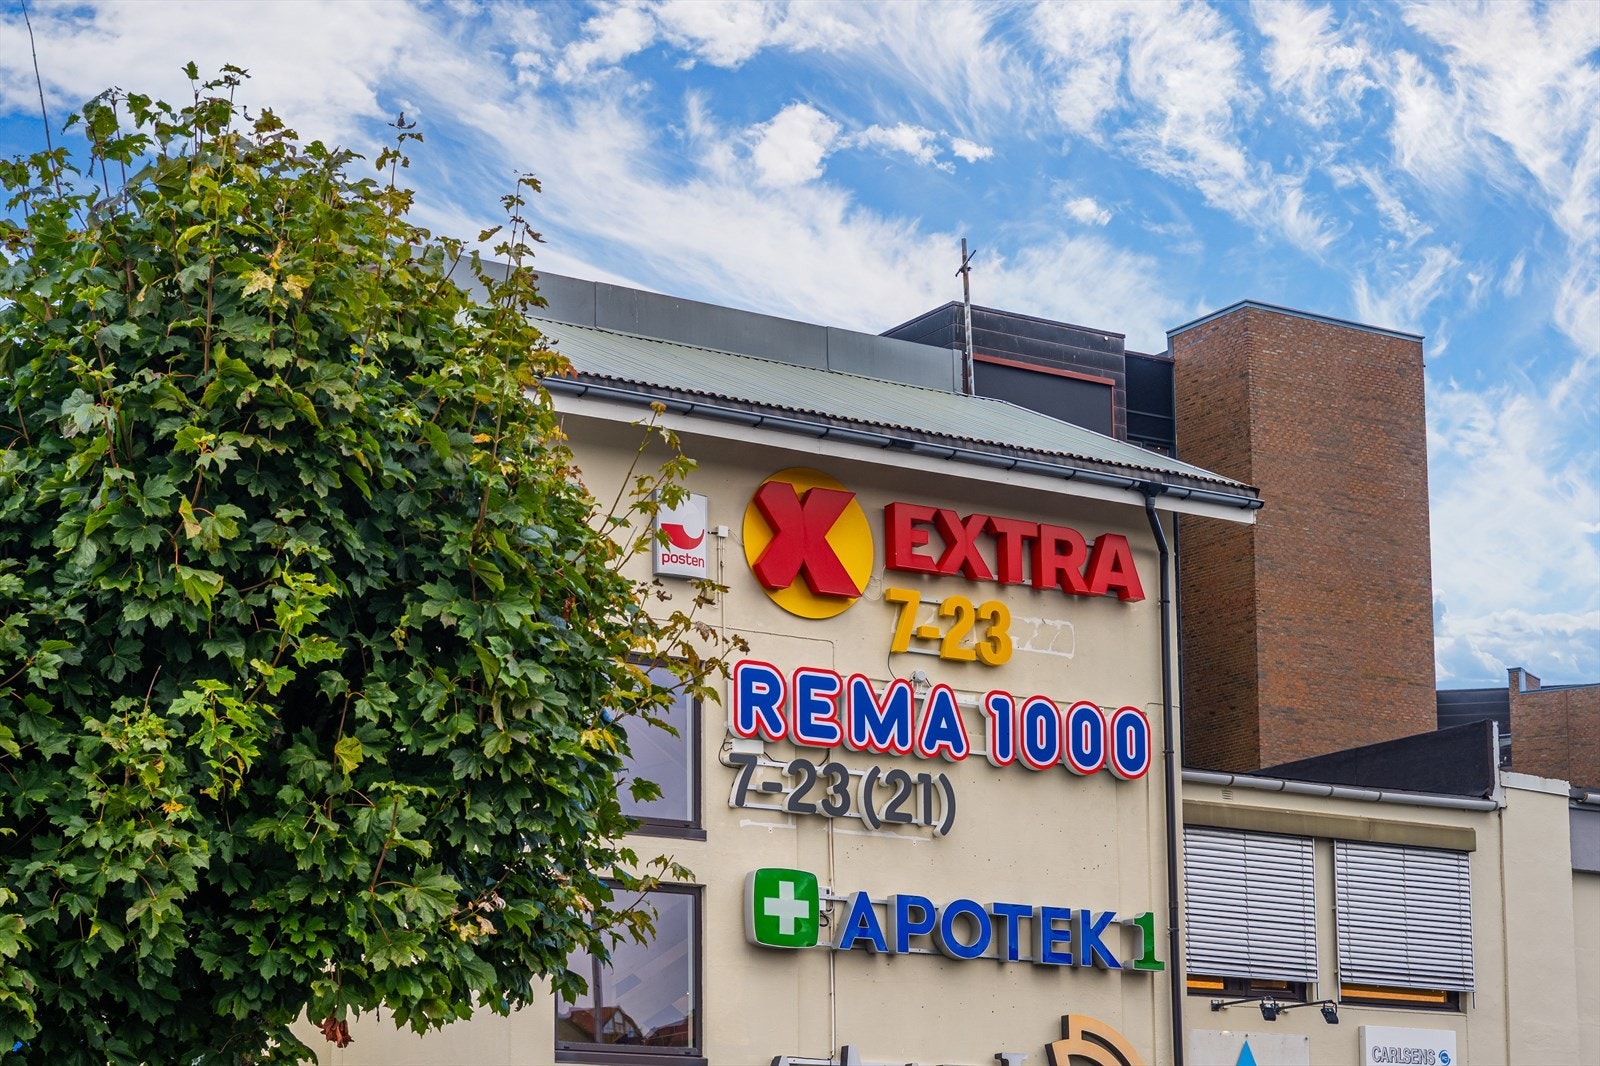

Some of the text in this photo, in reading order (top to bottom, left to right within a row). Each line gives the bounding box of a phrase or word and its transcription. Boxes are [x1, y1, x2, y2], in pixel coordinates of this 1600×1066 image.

[661, 552, 705, 568] posten
[753, 482, 1146, 602] X EXTRA
[885, 588, 1013, 666] 7-23
[729, 659, 1152, 780] REMA 1000
[834, 891, 1165, 972] APOTEK 1
[1371, 1045, 1436, 1066] CARLSENS
